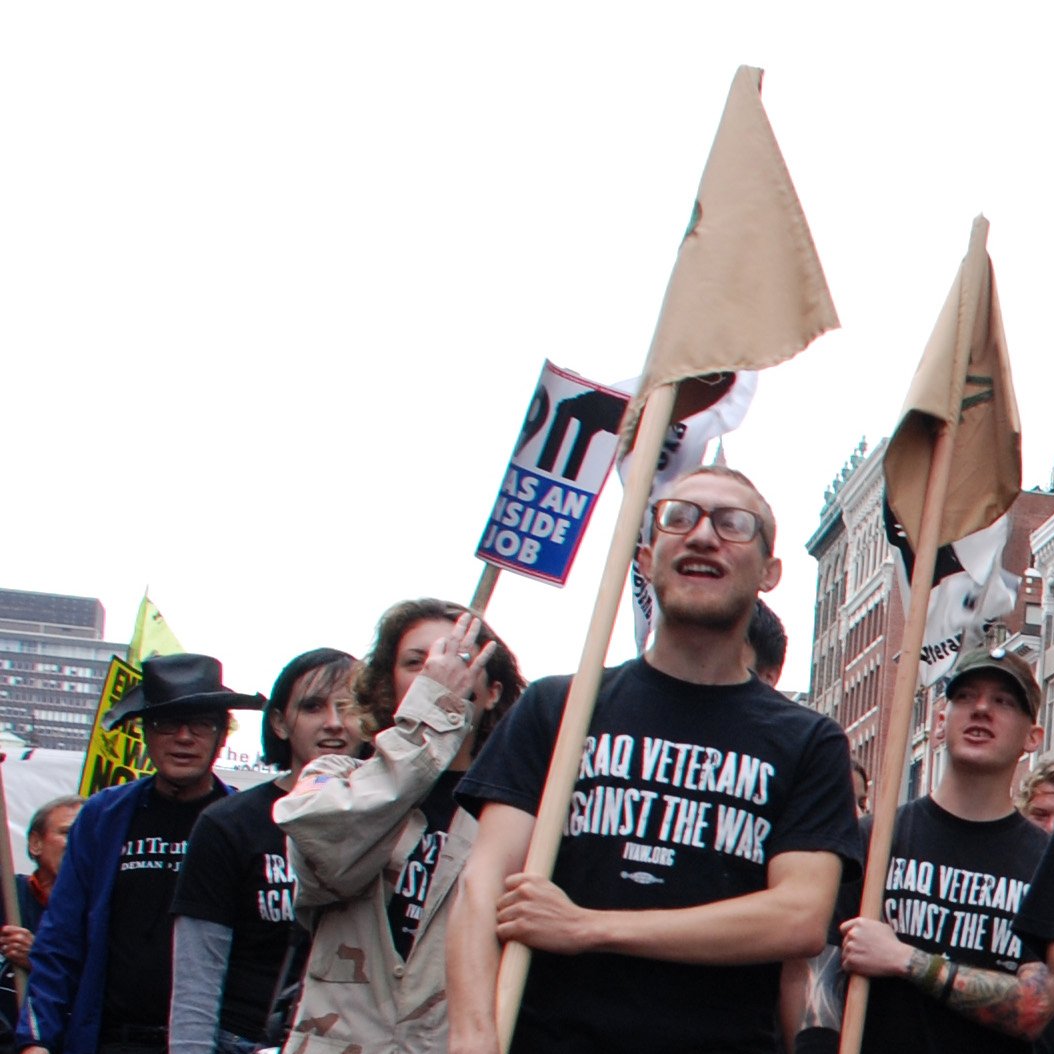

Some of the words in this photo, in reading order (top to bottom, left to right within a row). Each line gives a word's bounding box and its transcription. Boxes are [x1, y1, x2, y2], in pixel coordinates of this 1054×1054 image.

[540, 485, 589, 520] AN
[483, 524, 542, 565] JOB
[578, 733, 635, 780] RAQ
[641, 736, 776, 806] VETERANS
[659, 794, 713, 848] THE
[714, 804, 772, 865] WAR
[622, 841, 676, 867] IVAW.ORG
[885, 856, 934, 897] IRAQ
[884, 898, 950, 944] GAINST
[950, 911, 990, 951] THE
[991, 917, 1023, 959] WA
